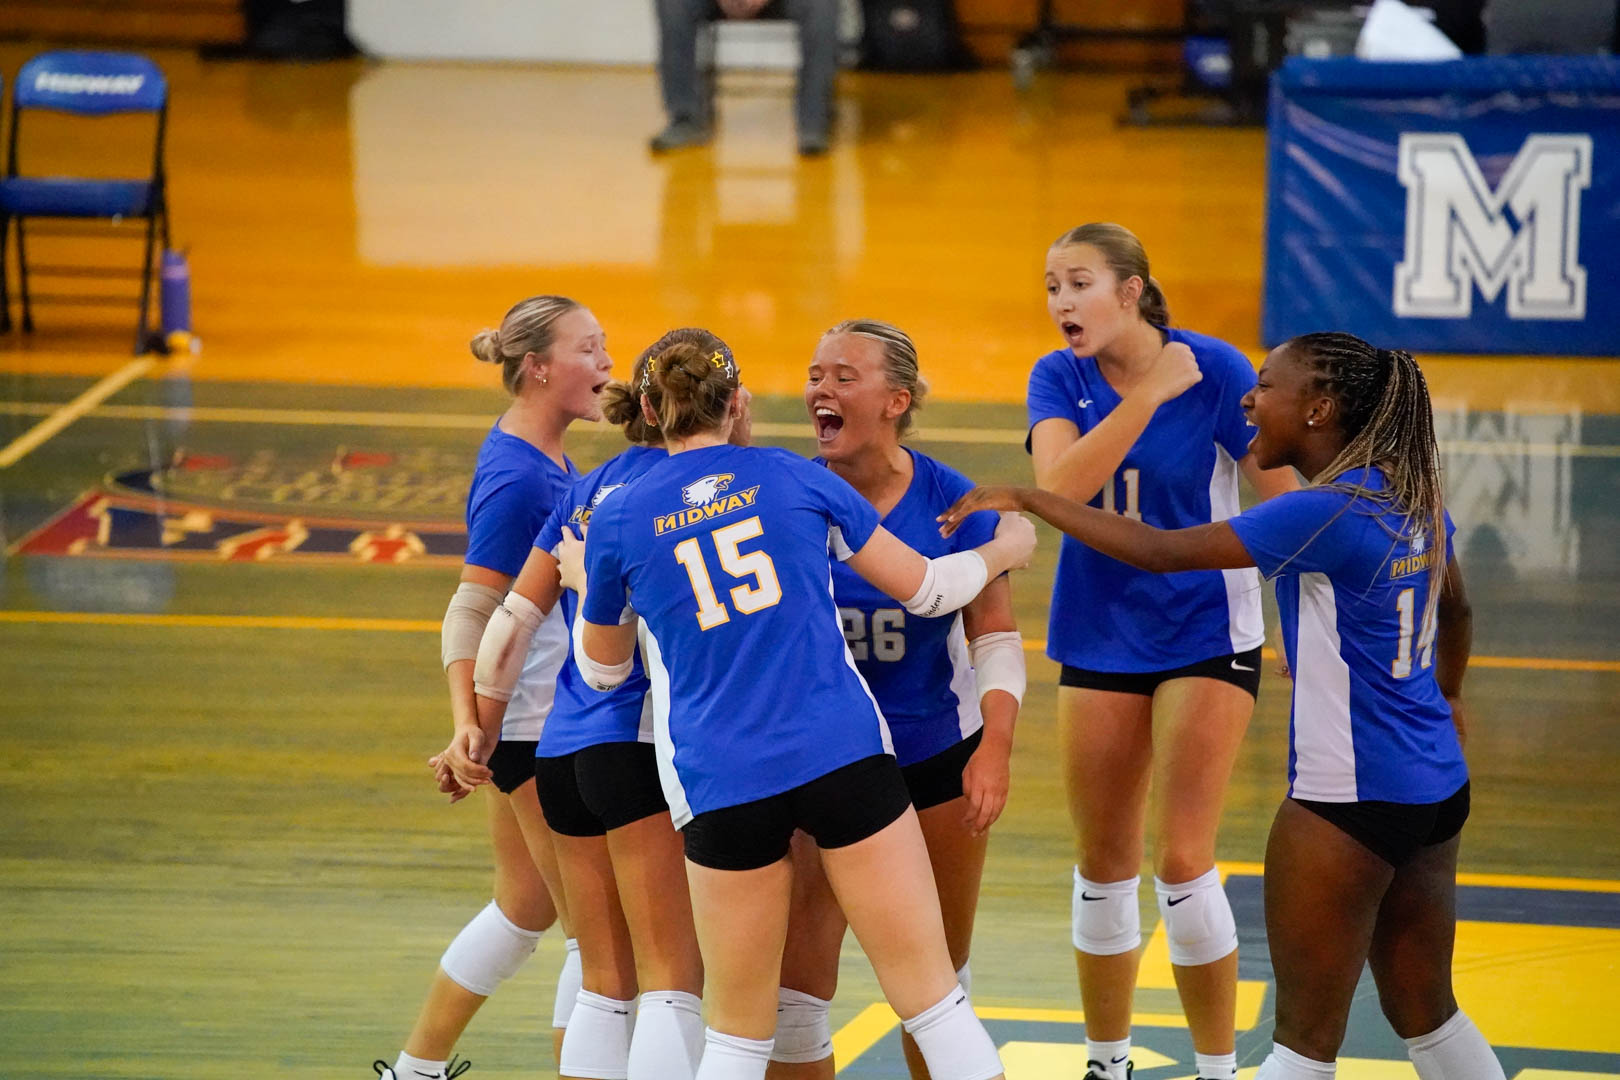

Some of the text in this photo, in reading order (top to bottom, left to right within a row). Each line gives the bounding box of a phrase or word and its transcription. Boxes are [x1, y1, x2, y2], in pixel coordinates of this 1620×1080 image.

[1393, 131, 1594, 320] M
[655, 487, 759, 535] MIDWAY
[674, 516, 782, 632] 15
[1390, 551, 1435, 578] MIDW
[839, 608, 906, 662] 26
[1391, 588, 1438, 679] 14
